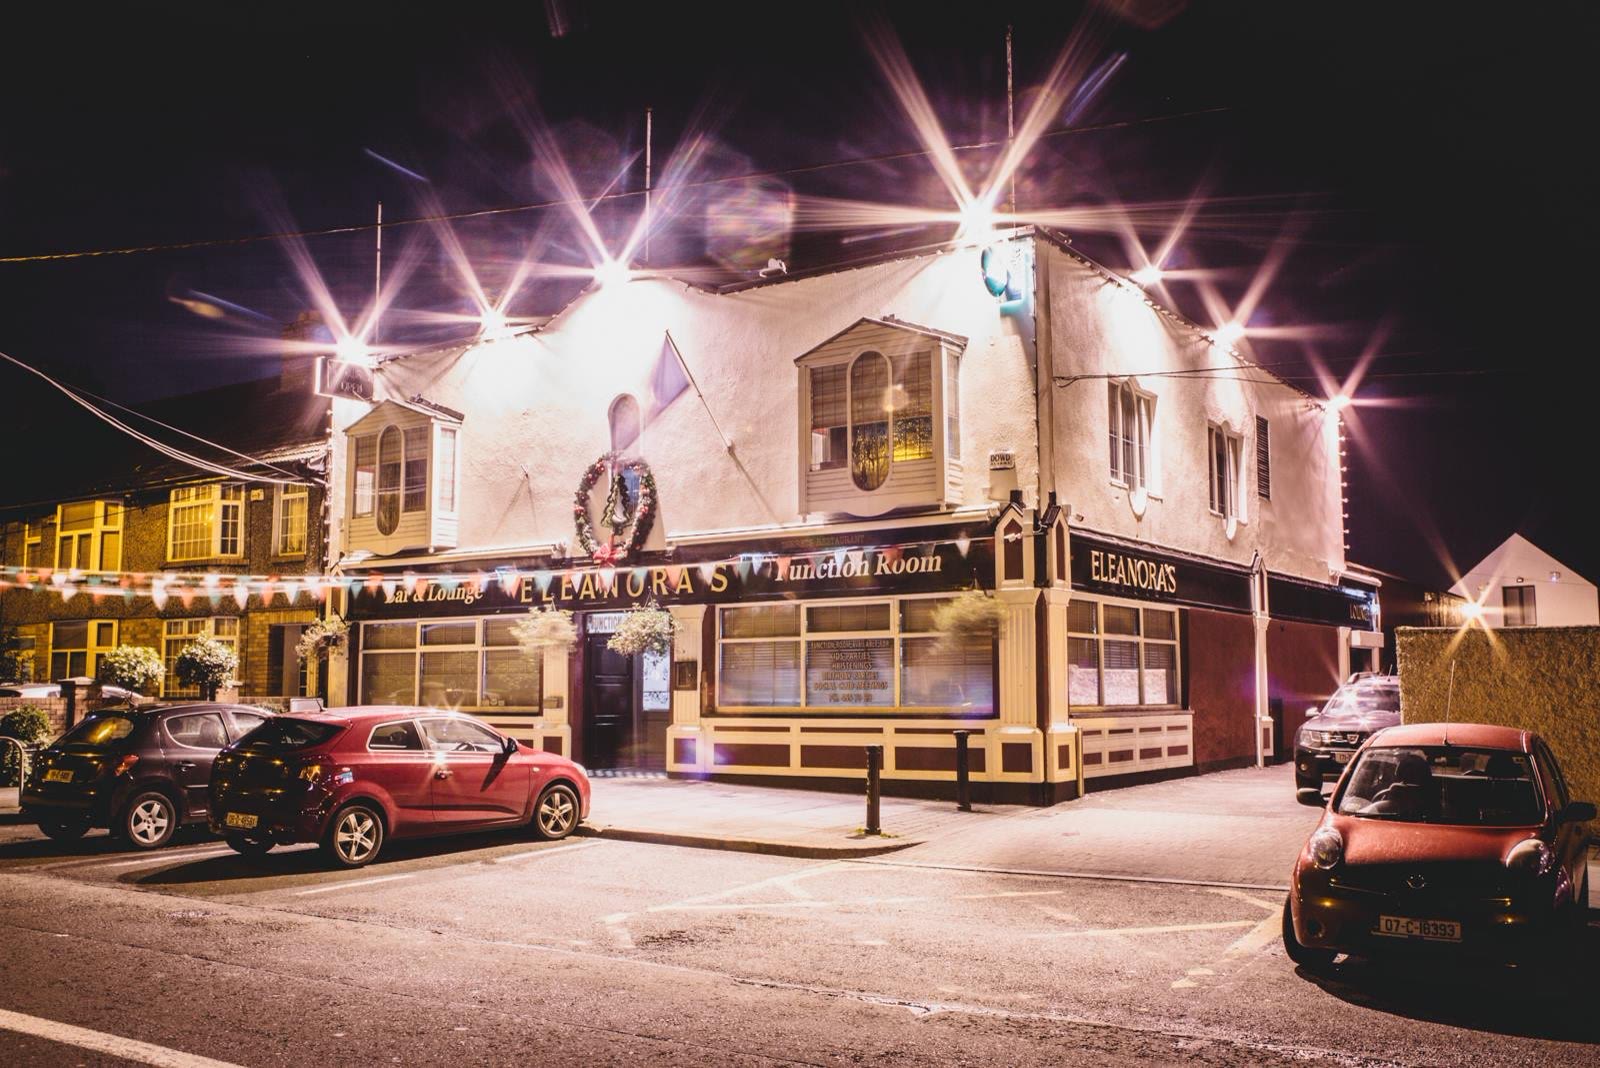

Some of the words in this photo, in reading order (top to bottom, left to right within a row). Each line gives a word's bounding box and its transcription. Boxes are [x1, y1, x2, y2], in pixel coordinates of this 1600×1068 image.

[874, 553, 942, 576] Room
[1090, 550, 1177, 593] ELEANORA'S
[427, 584, 483, 605] Lounge
[520, 563, 729, 603] ELEANORAS
[1385, 918, 1456, 937] 07-C-18393
